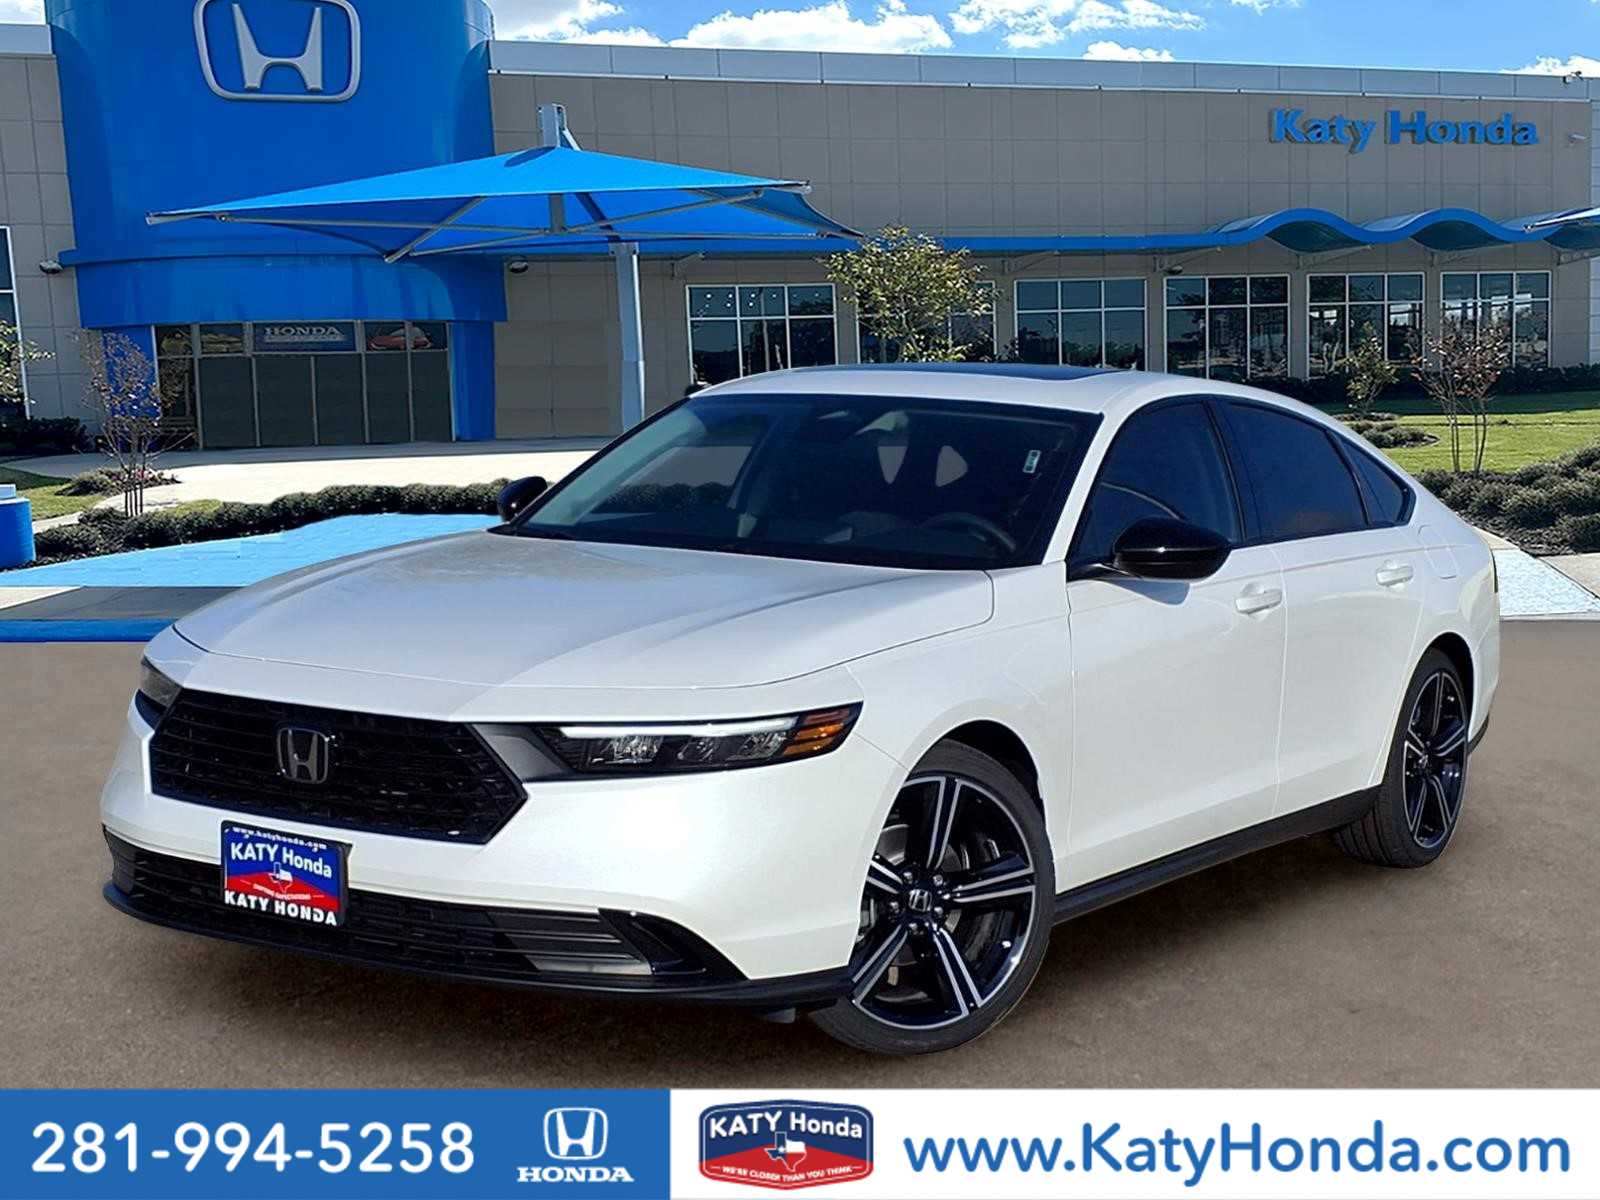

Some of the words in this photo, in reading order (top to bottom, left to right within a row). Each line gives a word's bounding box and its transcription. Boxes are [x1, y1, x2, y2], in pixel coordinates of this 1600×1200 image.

[1269, 108, 1376, 153] Katy
[1384, 110, 1539, 145] Honda
[264, 326, 344, 336] HONDA
[230, 842, 279, 862] KATY
[281, 846, 333, 879] Honda
[224, 890, 269, 911] KATY
[273, 899, 337, 926] HONDA
